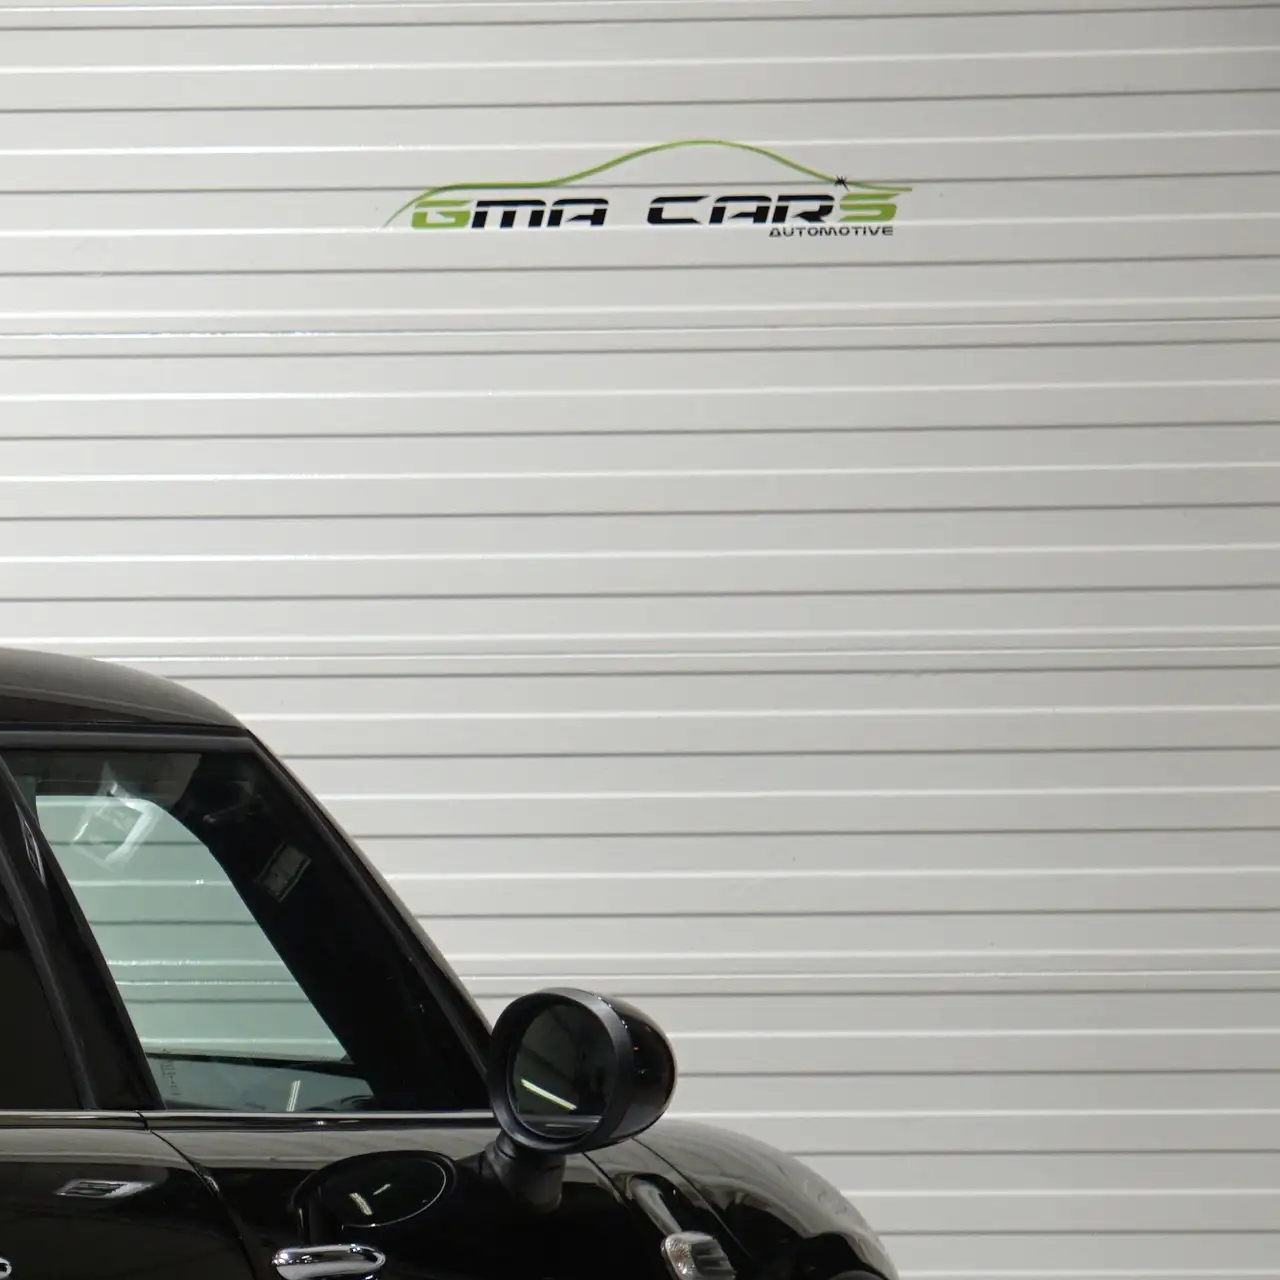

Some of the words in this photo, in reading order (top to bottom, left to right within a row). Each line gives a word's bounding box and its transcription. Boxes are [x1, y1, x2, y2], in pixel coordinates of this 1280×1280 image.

[411, 198, 609, 230] GMA
[647, 193, 900, 225] CARS
[768, 225, 894, 238] AUTOMOTIVE
